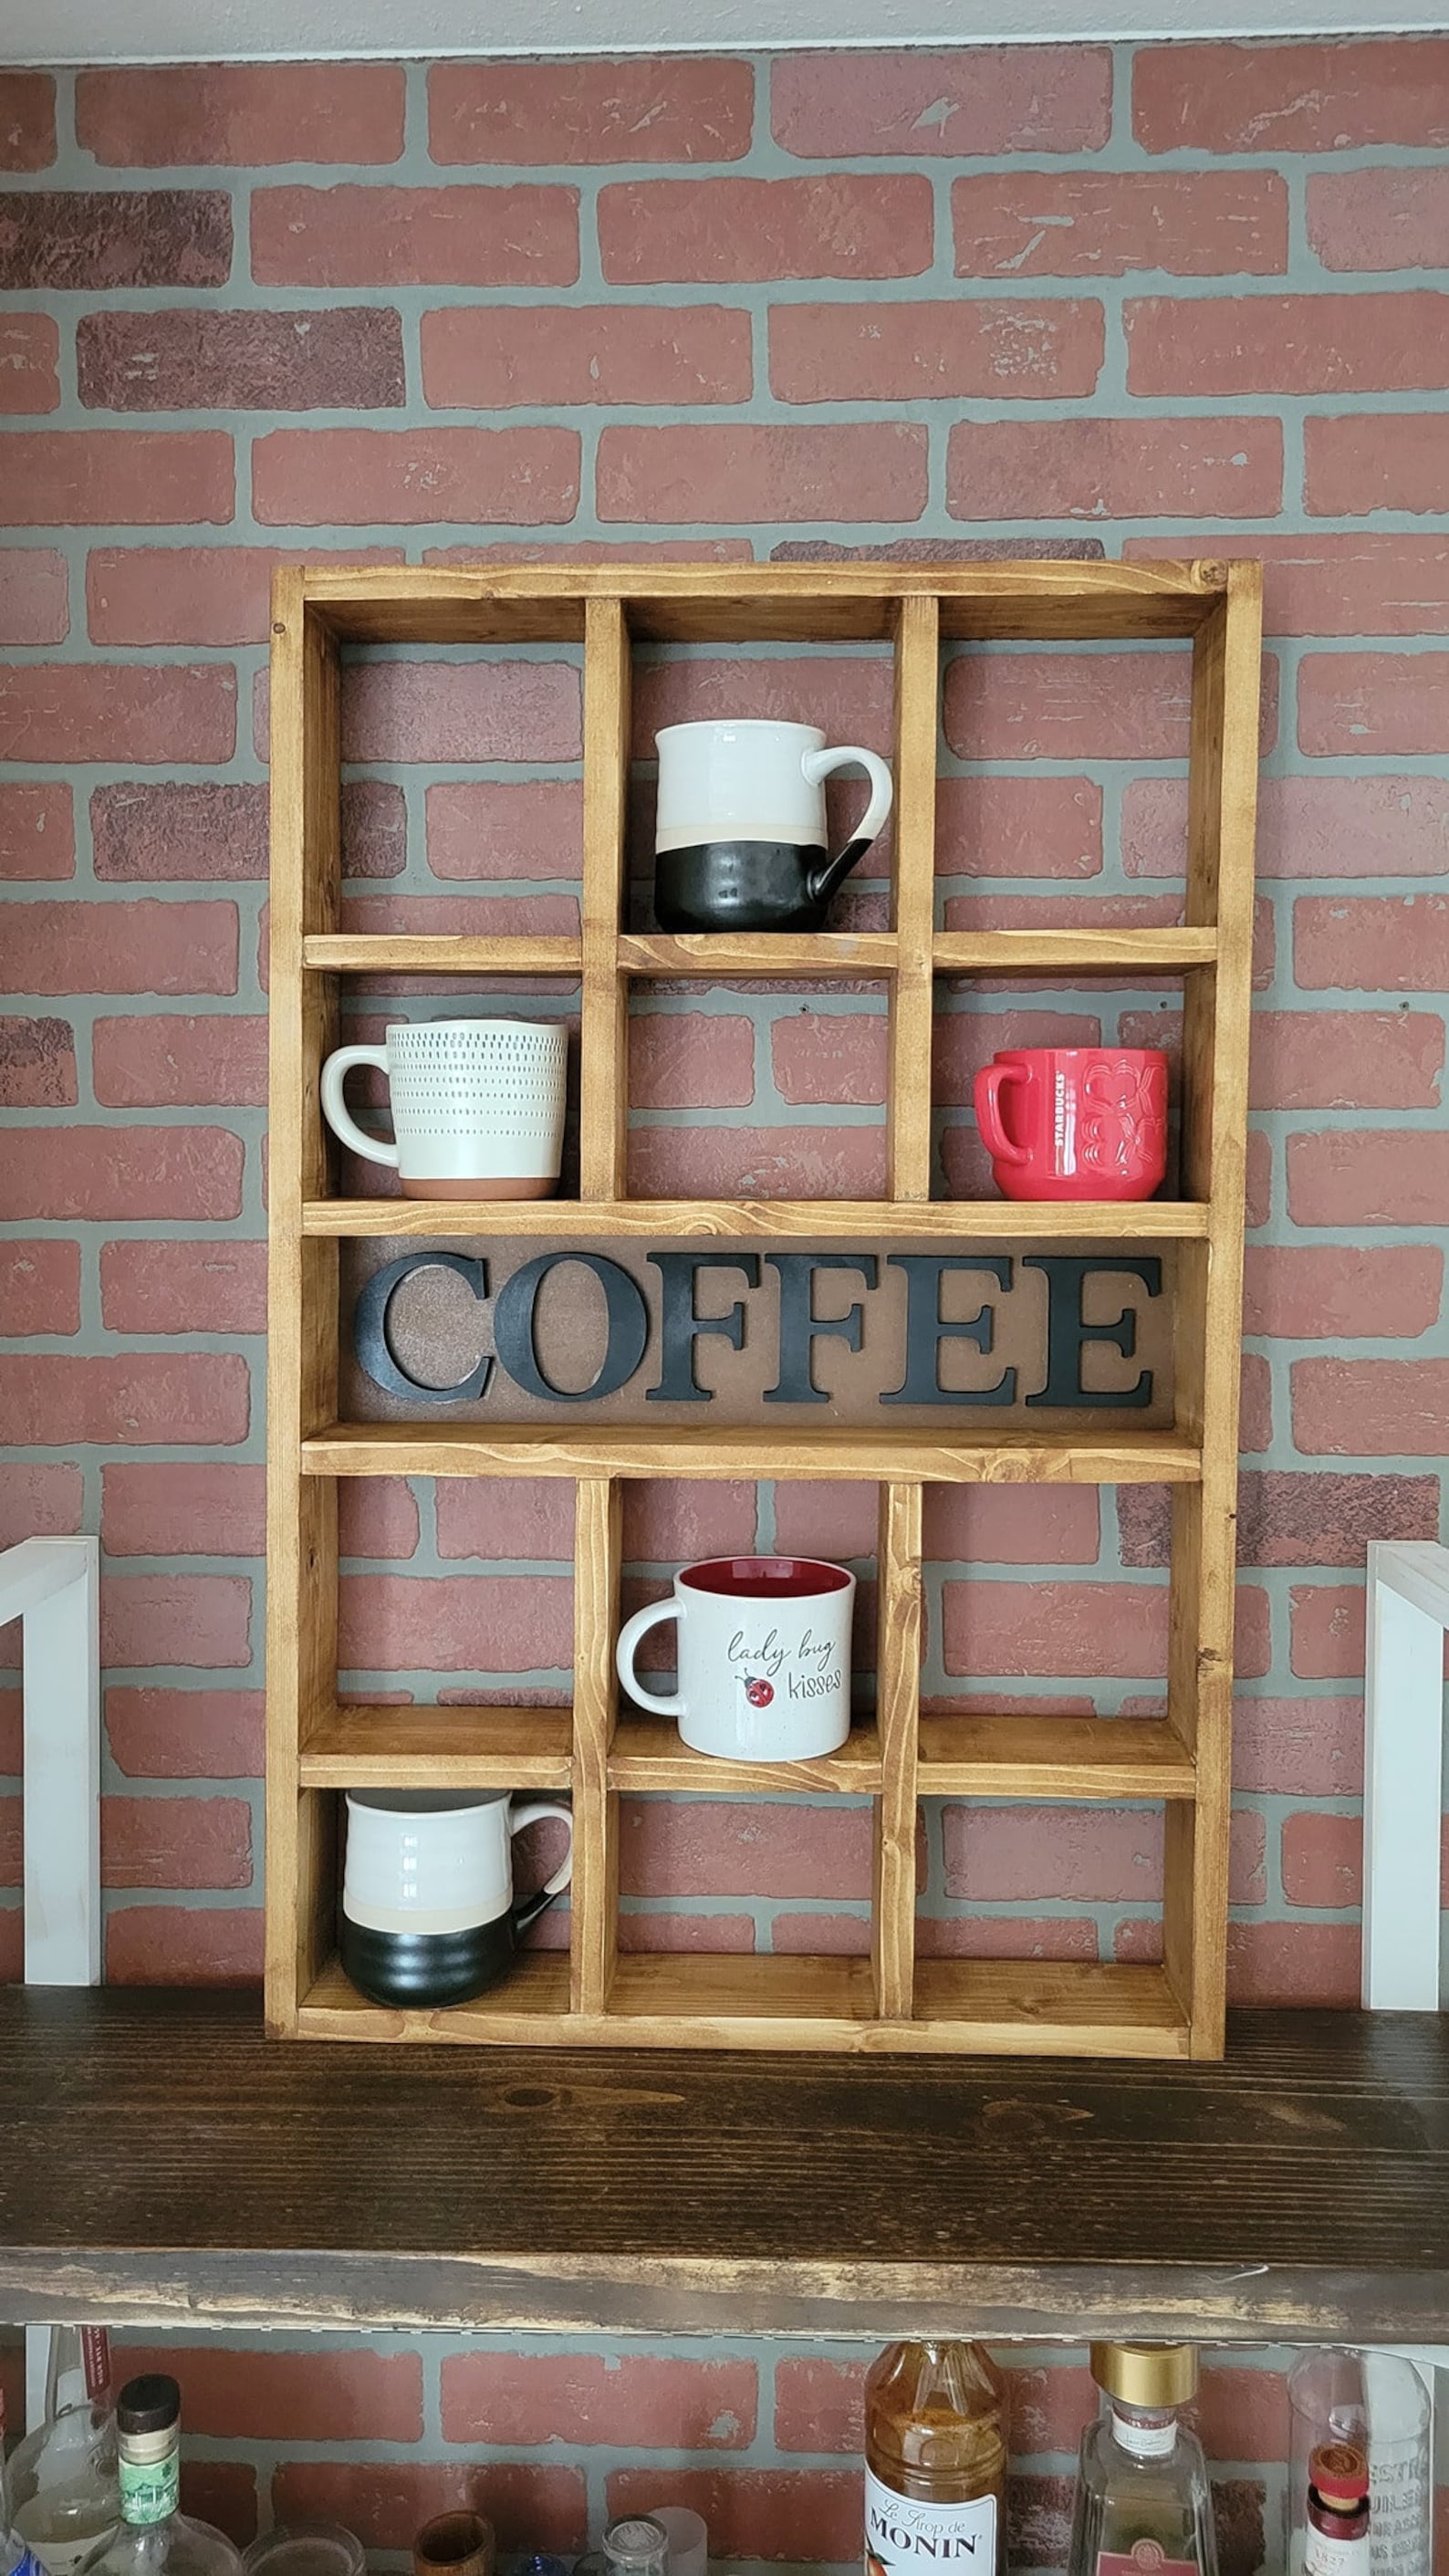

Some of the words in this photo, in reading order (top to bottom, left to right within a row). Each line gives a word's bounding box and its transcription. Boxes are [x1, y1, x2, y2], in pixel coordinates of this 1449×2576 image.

[1055, 1072, 1066, 1146] STARBUCKS
[358, 1251, 1162, 1408] COFFEE
[727, 1629, 792, 1676] lady
[797, 1629, 836, 1672] bug
[788, 1669, 842, 1699] kisses
[870, 2506, 979, 2558] MONIN
[879, 2499, 900, 2519] Le
[948, 2521, 965, 2533] de
